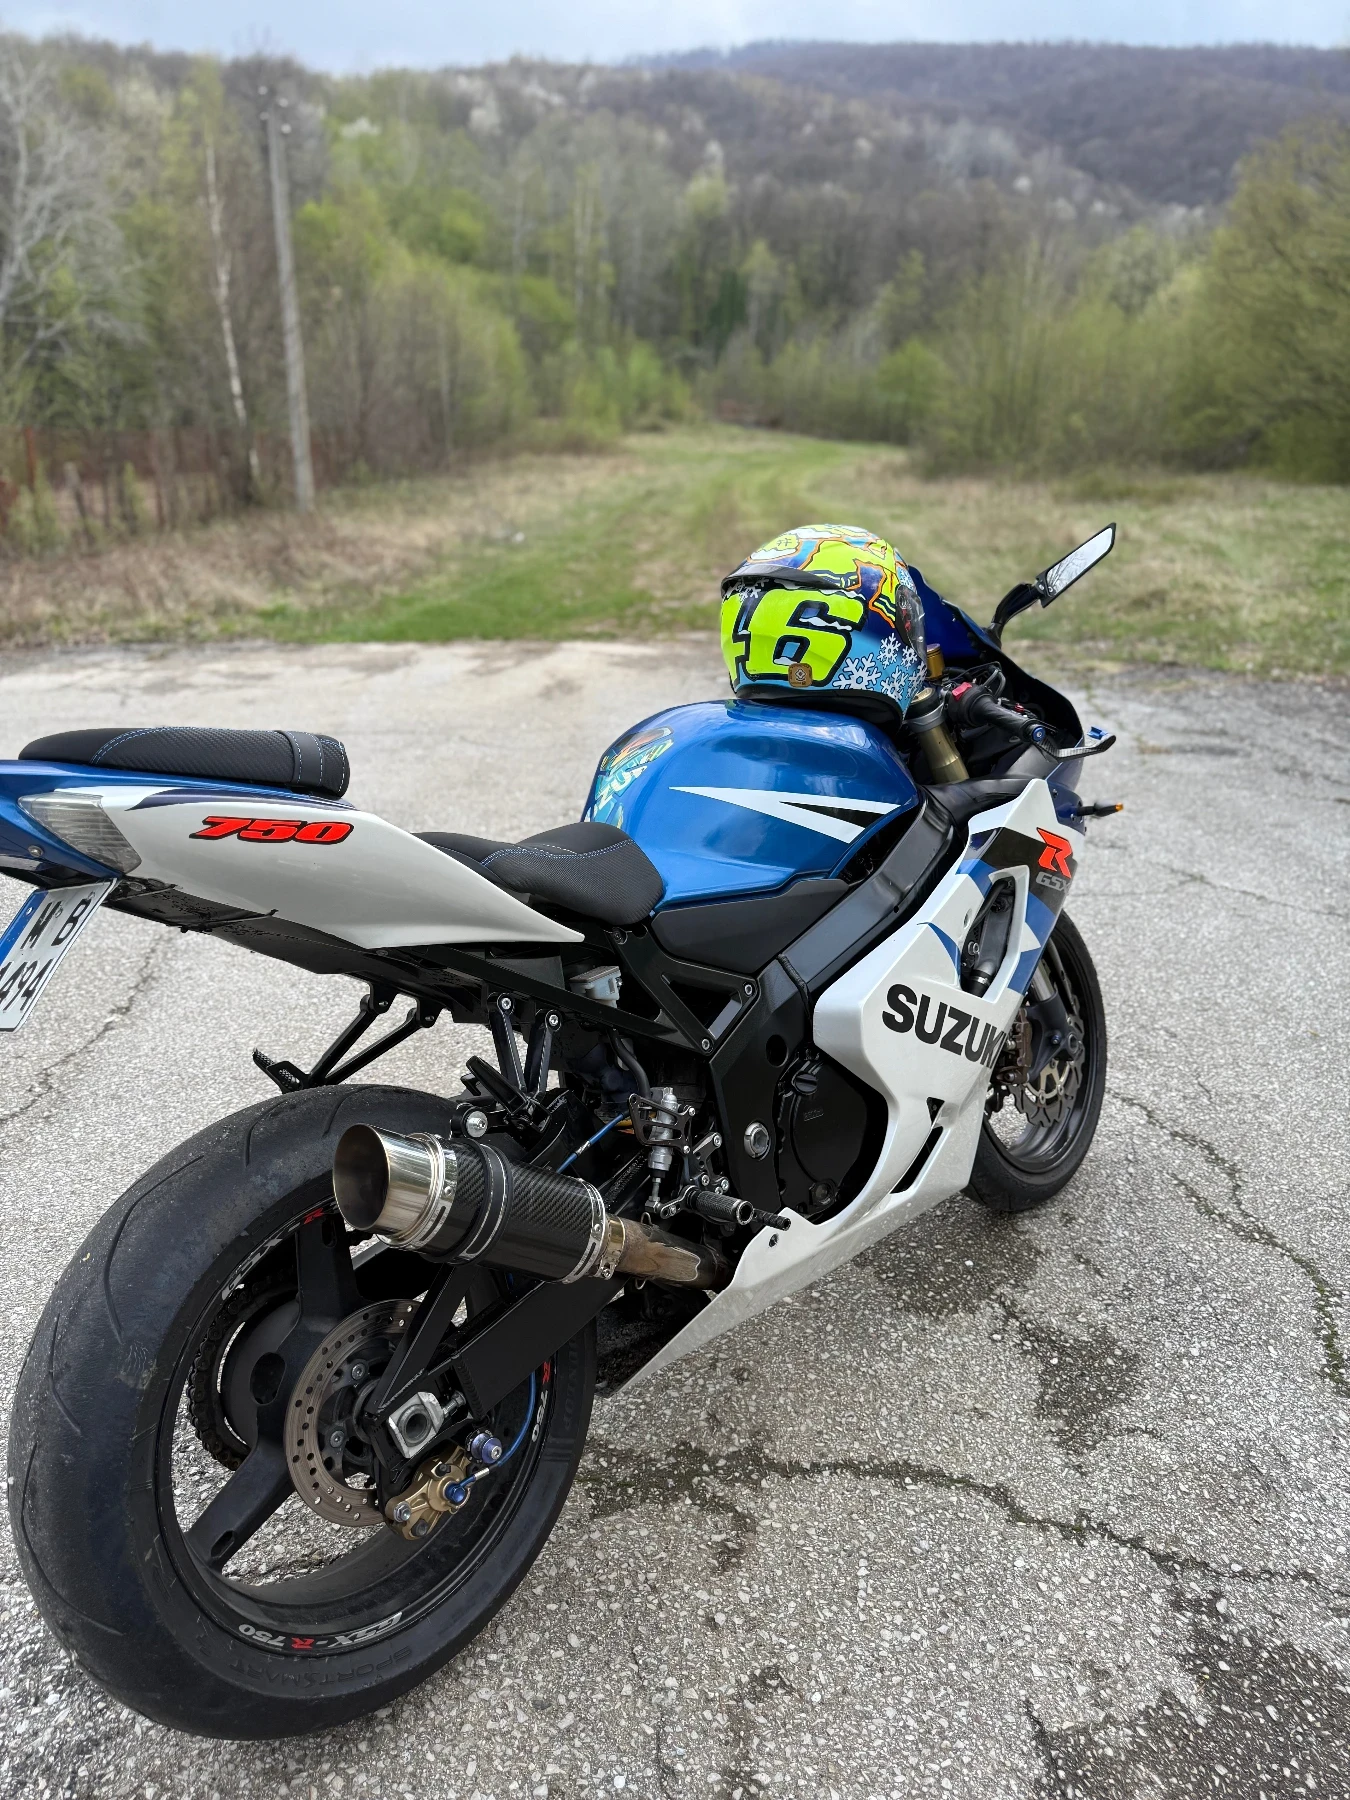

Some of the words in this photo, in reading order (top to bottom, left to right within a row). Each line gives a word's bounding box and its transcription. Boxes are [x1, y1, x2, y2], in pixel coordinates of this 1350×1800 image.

[189, 815, 354, 844] 750
[1036, 826, 1073, 879] R
[50, 898, 92, 947] B
[882, 984, 1007, 1069] SUZUKI
[238, 1624, 286, 1647] 750
